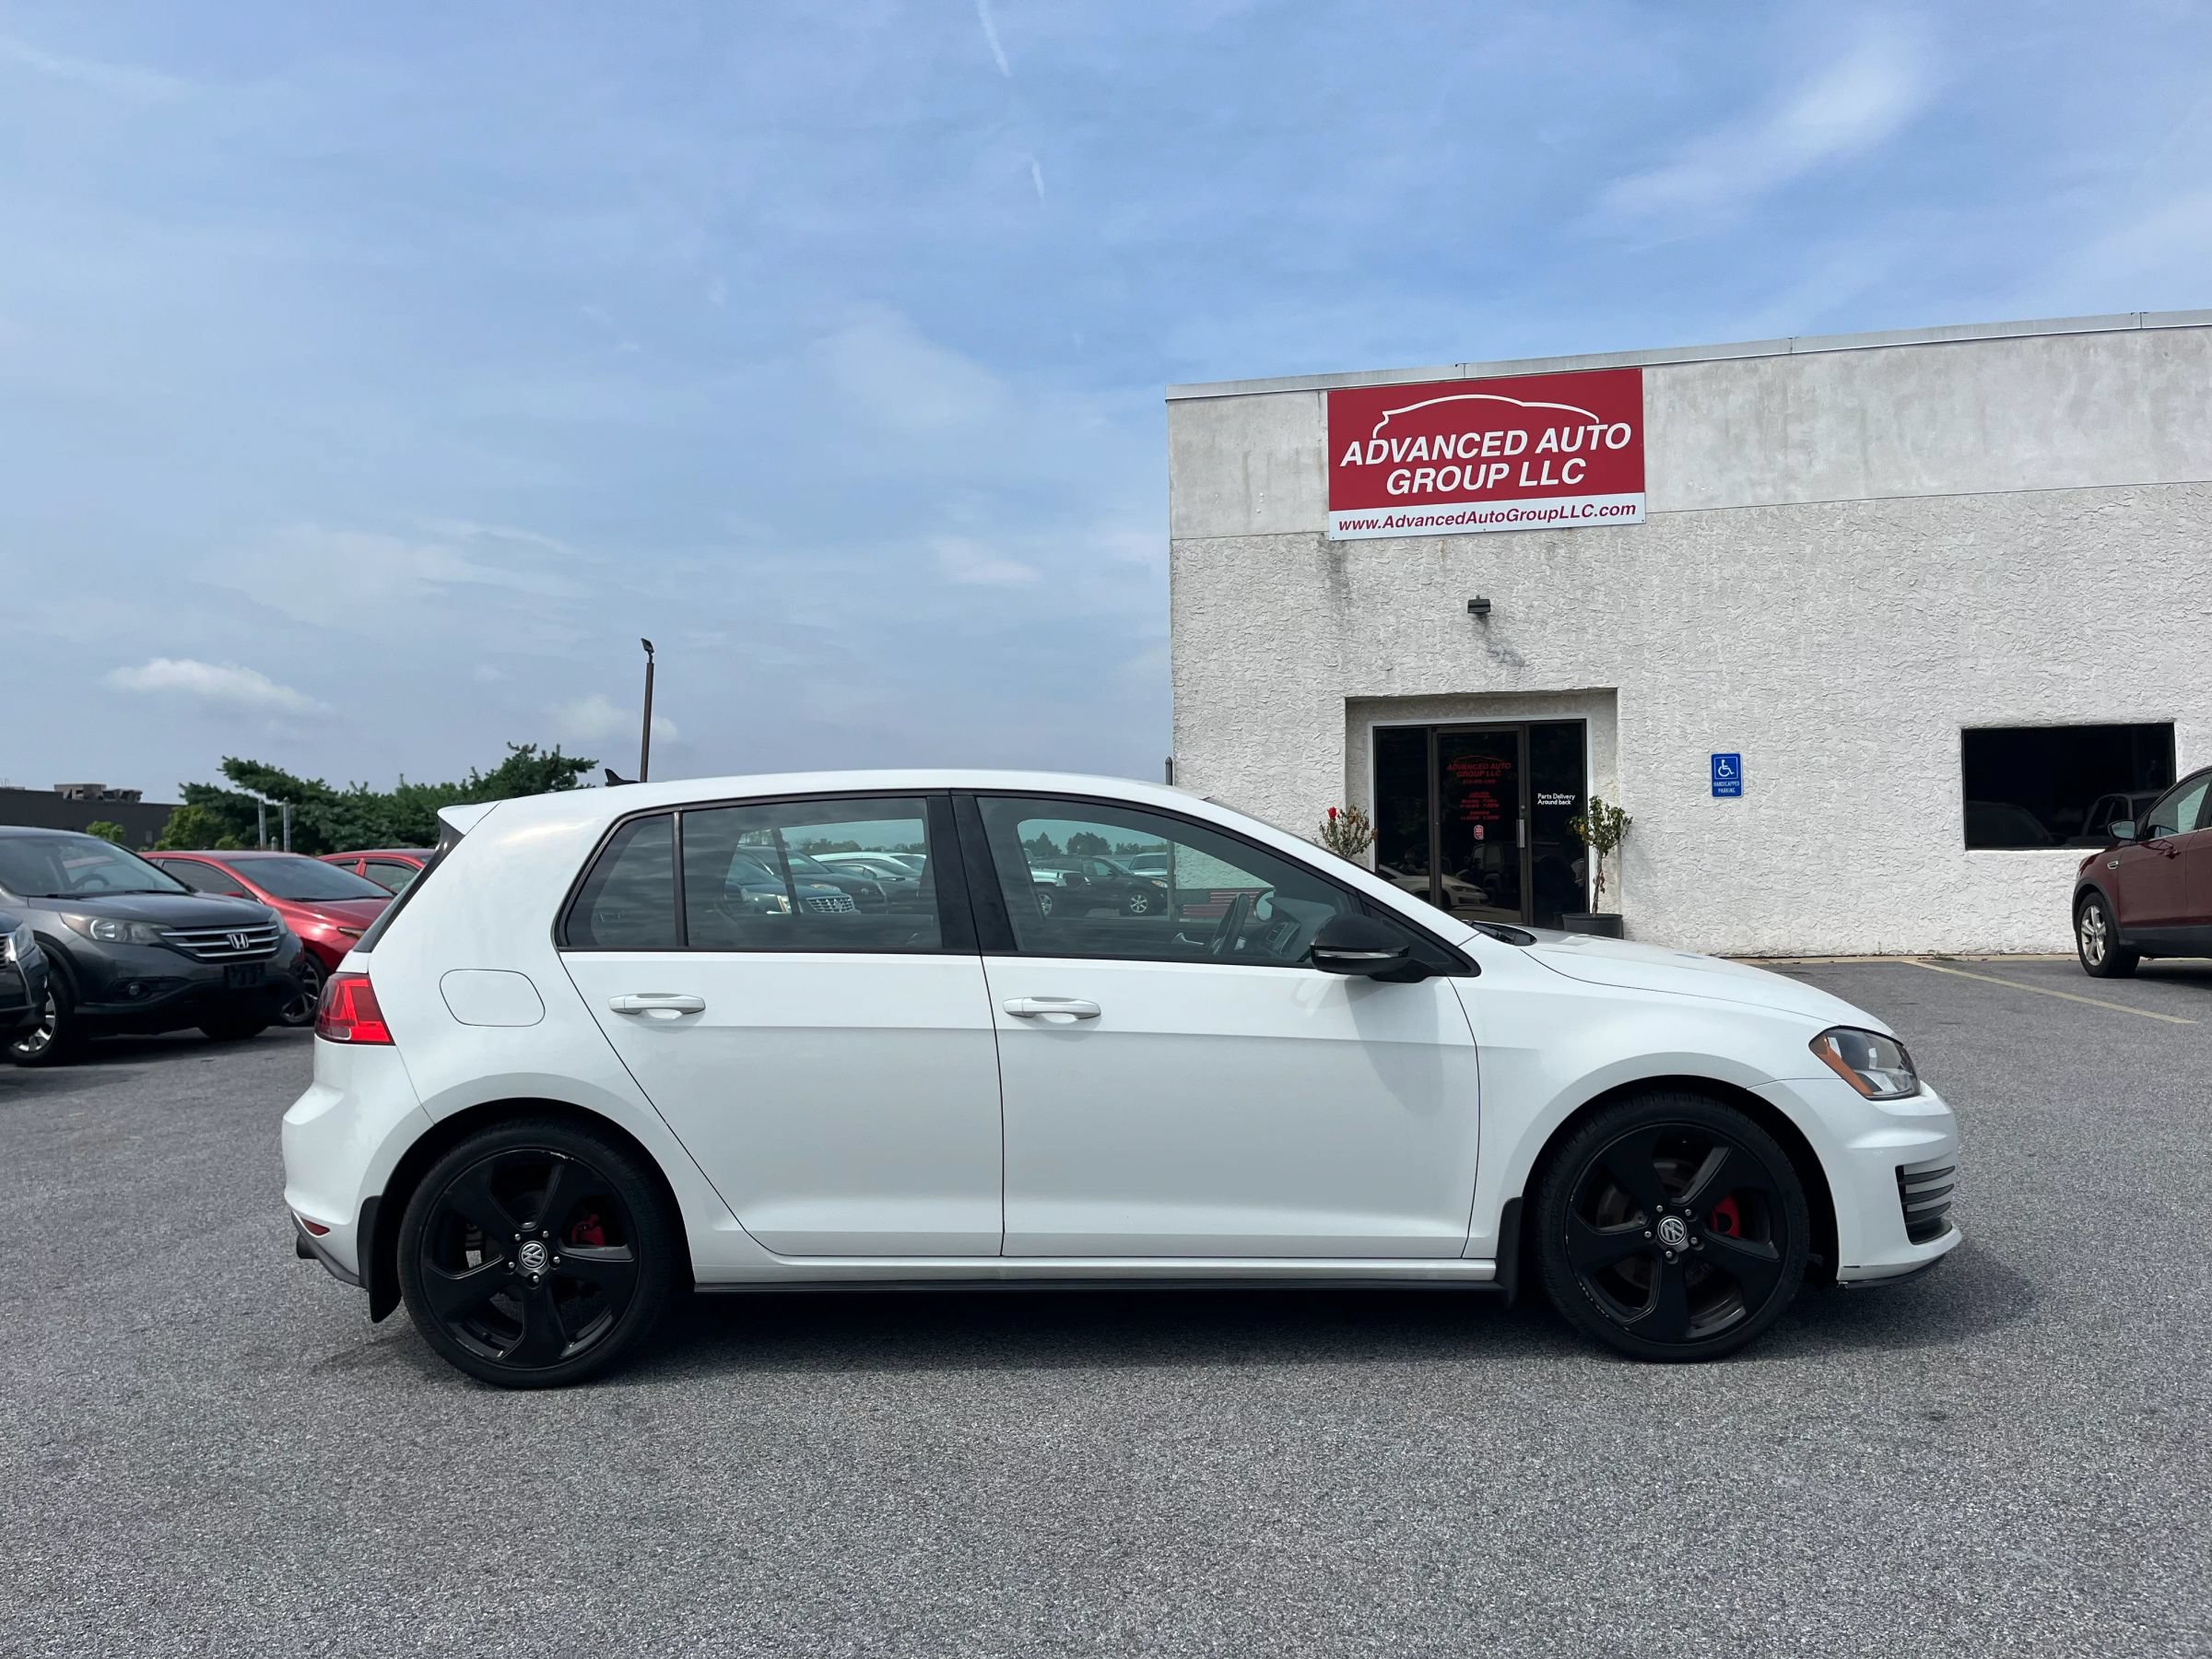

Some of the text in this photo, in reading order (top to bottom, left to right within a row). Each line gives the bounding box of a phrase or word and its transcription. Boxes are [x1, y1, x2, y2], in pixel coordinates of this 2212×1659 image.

[1339, 422, 1631, 466] ADVANCED AUTO
[1386, 458, 1586, 496] GROUP LLC
[1338, 503, 1637, 532] www.AdvancedAutoGroupLLC.com
[1456, 770, 1485, 778] GROUP
[1553, 793, 1576, 801] Delivery
